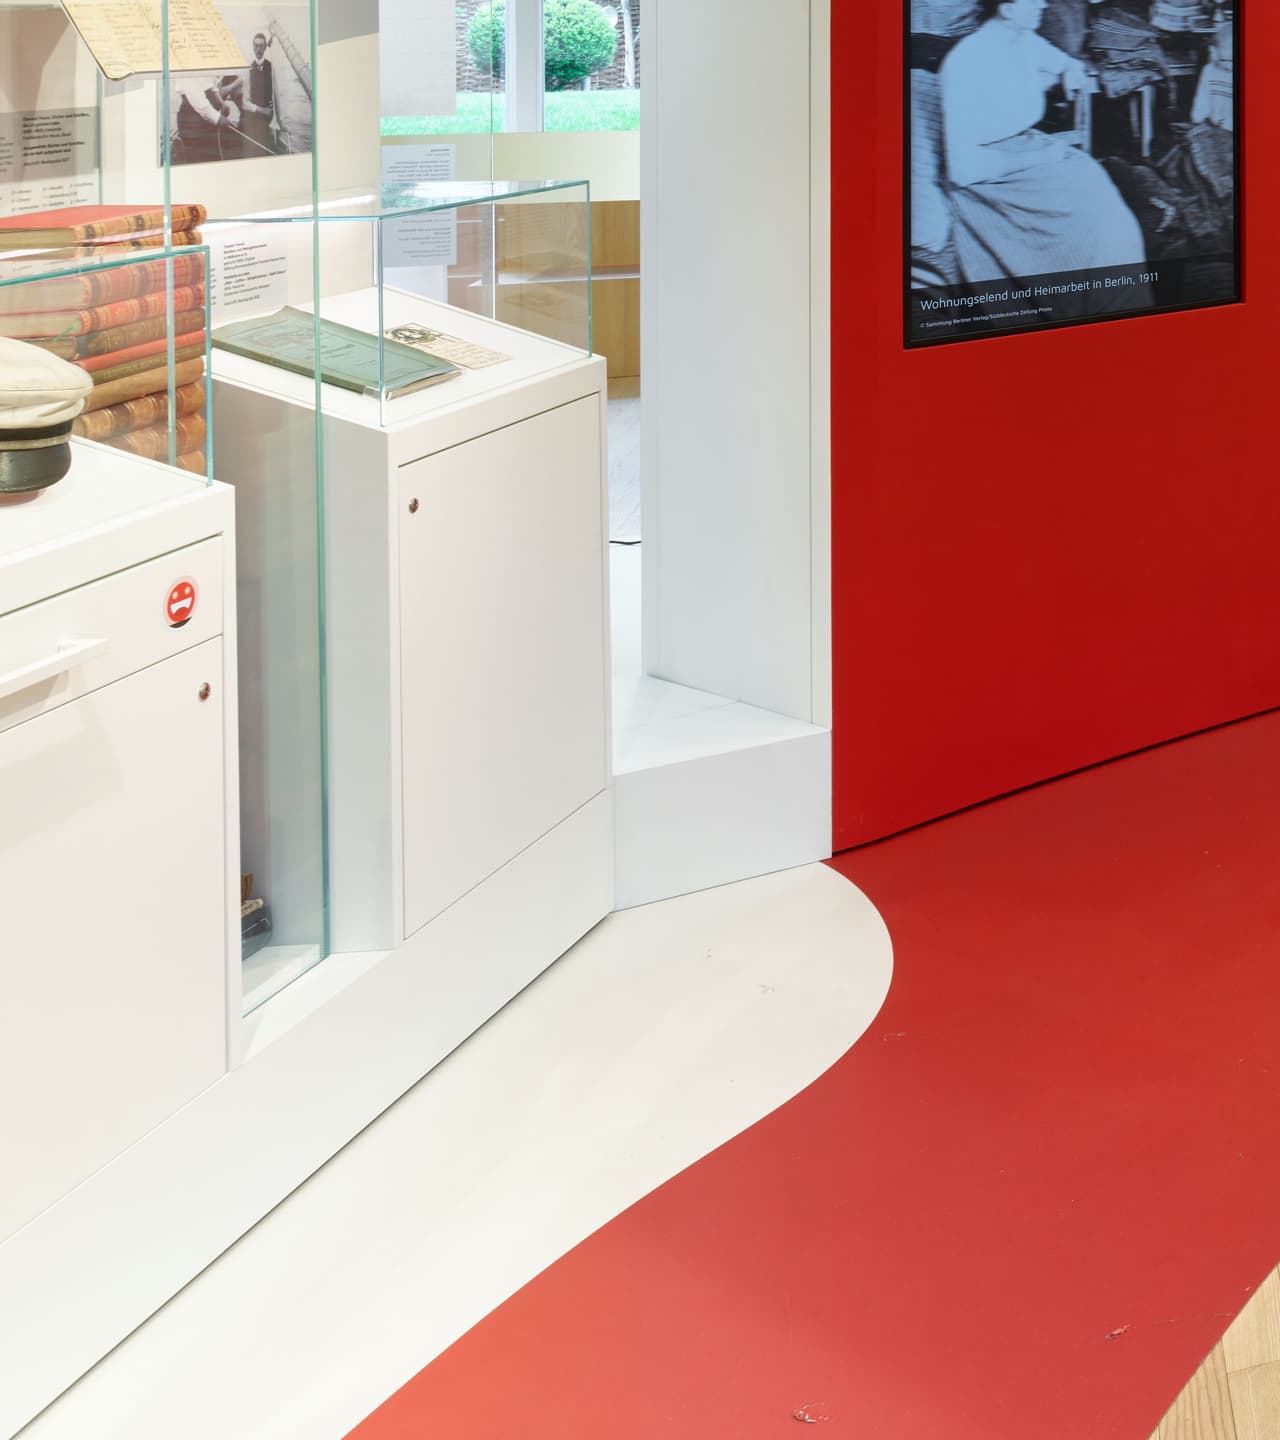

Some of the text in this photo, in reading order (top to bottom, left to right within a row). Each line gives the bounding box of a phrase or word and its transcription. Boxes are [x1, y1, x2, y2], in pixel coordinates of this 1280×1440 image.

[920, 272, 1159, 311] Wohnungselend und Heimarbeit in Berlin, 1911
